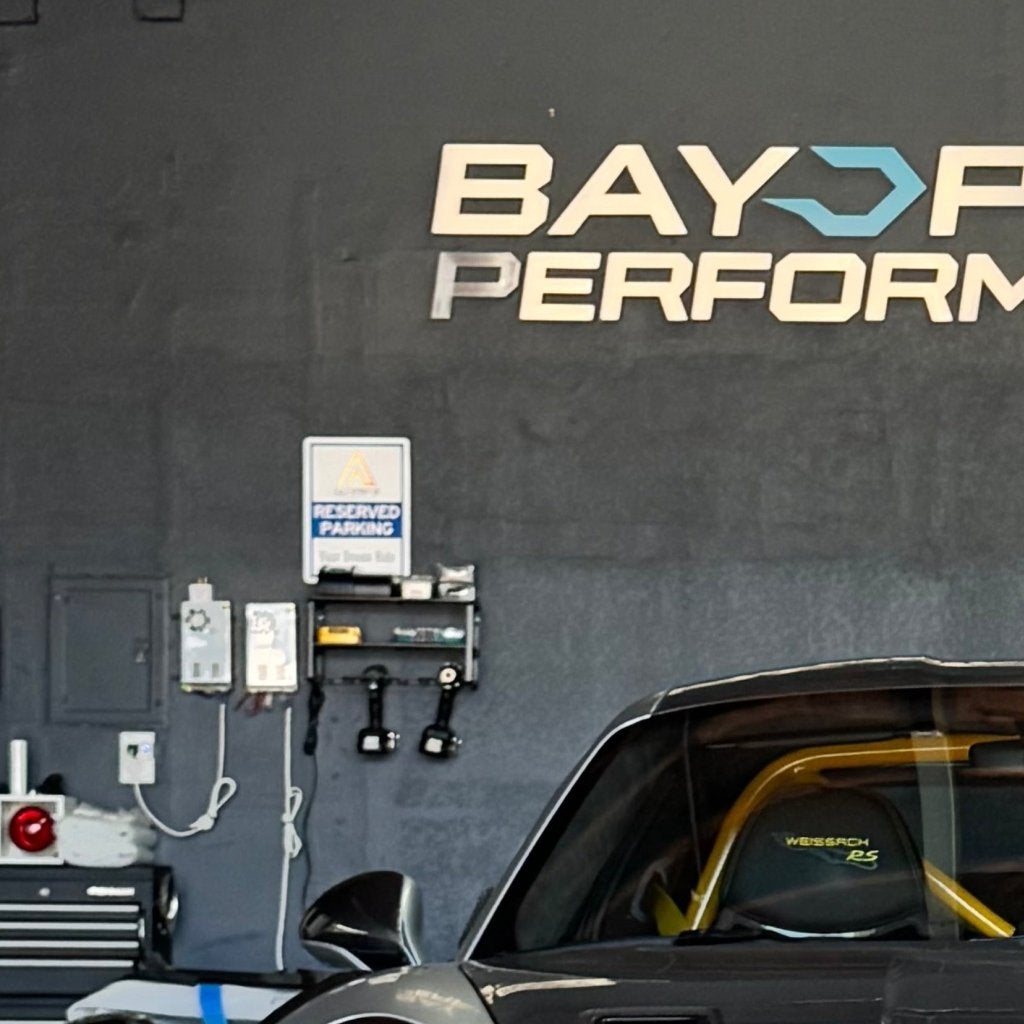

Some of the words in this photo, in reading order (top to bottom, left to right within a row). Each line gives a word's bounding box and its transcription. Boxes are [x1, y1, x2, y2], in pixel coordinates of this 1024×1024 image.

[313, 504, 401, 519] RESERVED
[318, 521, 394, 536] PARKING
[785, 836, 869, 847] WEISSACH
[846, 850, 879, 862] RS
